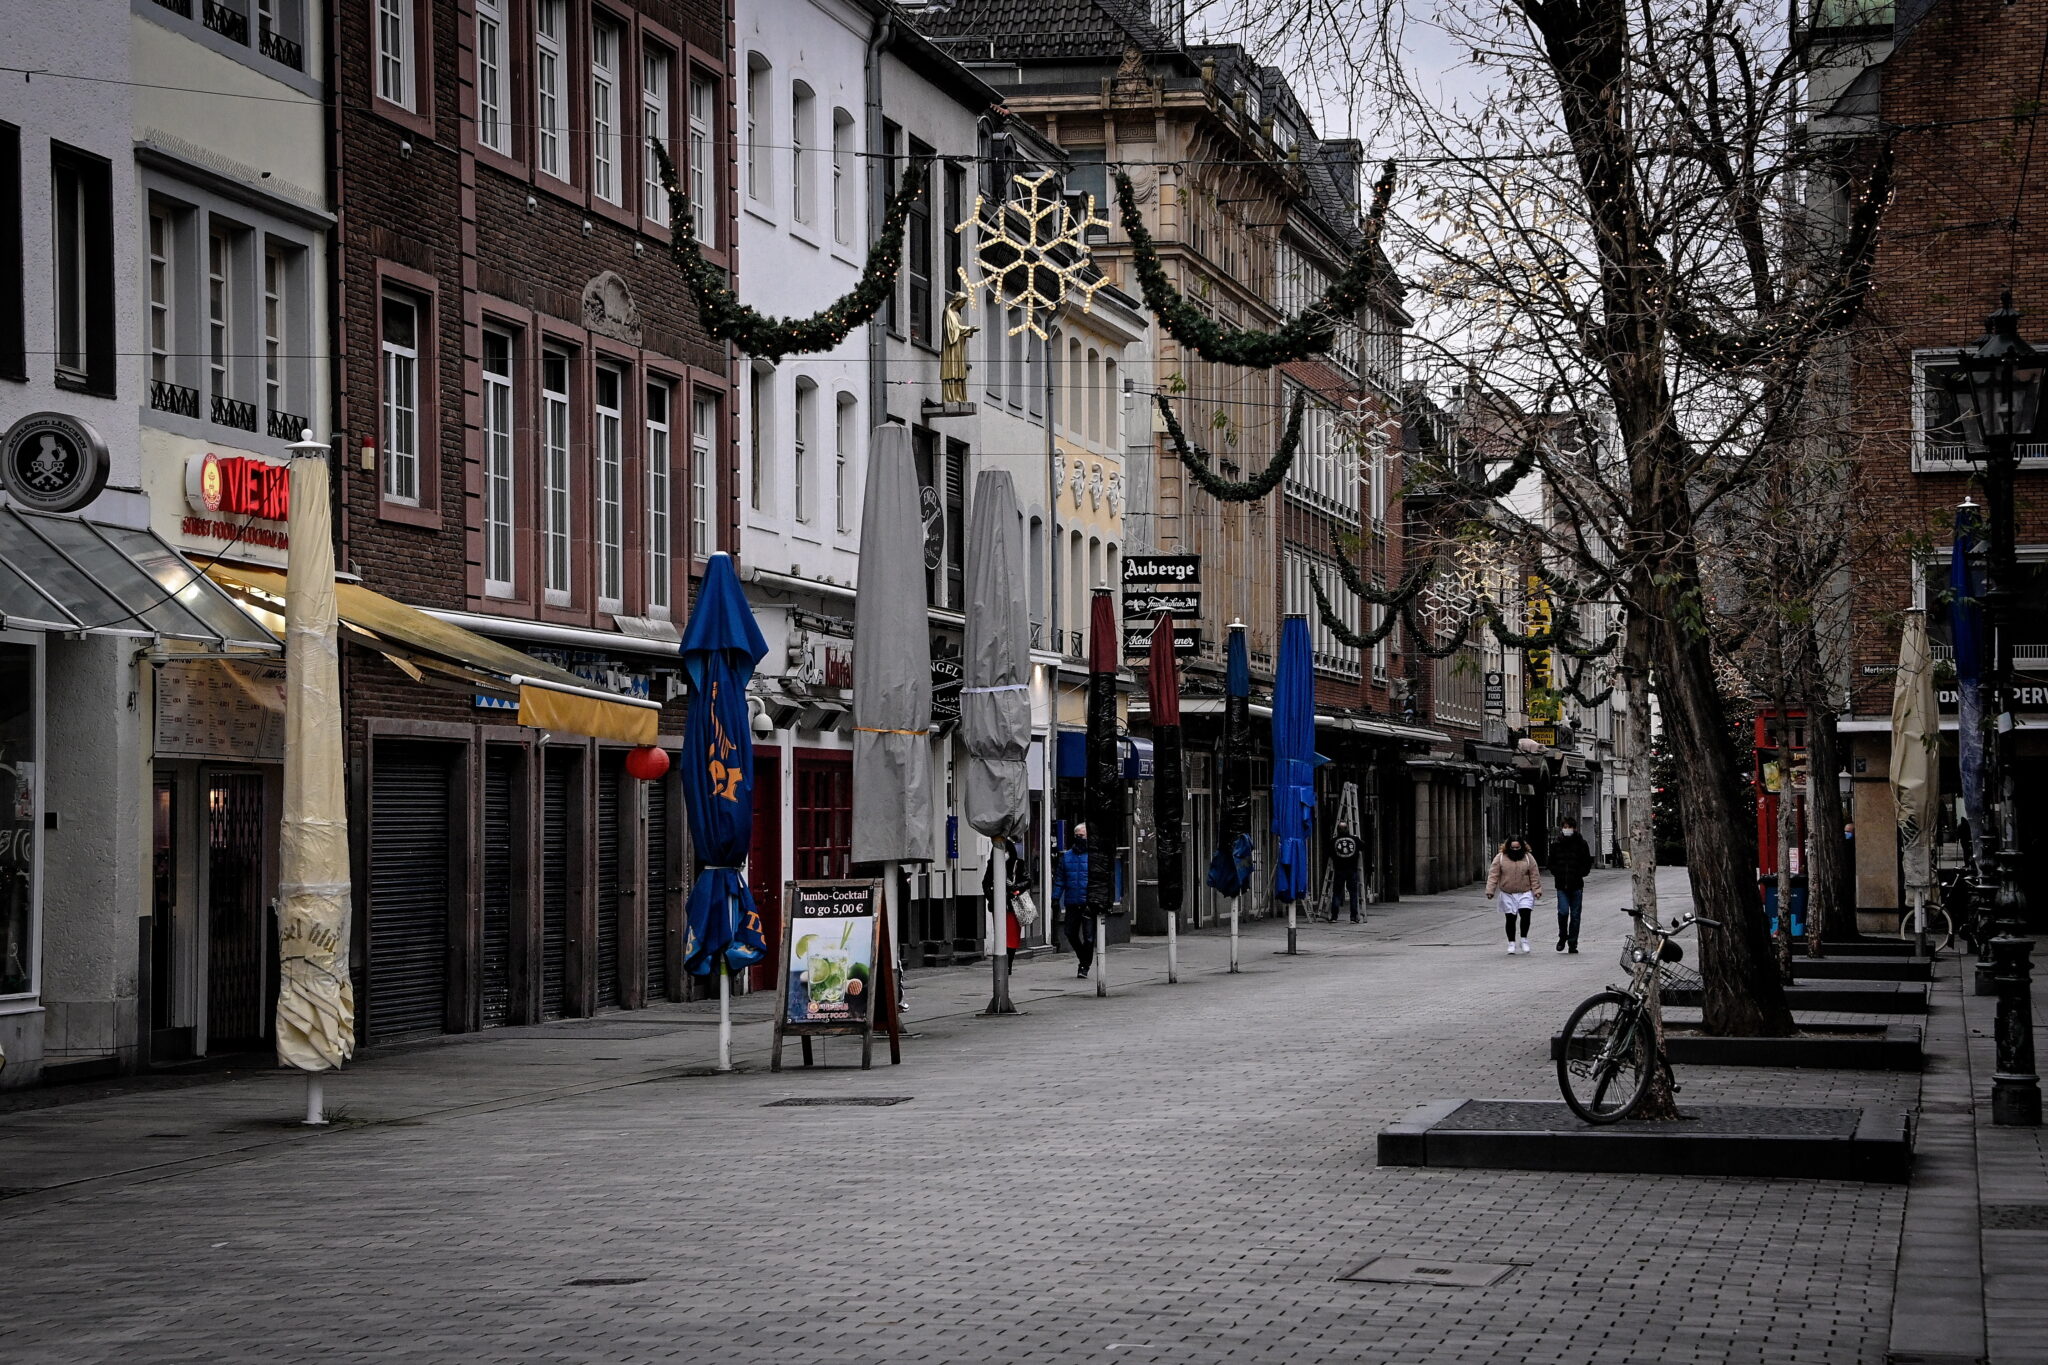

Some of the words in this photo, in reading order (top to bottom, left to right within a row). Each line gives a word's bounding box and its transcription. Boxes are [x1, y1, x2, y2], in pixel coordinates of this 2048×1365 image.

[226, 457, 289, 521] VIETNA
[1124, 559, 1195, 580] Auberge
[931, 662, 959, 678] NGEL
[1487, 692, 1501, 700] FOOD
[800, 890, 868, 902] Jumbo-Cocktail
[804, 905, 816, 915] to
[817, 906, 831, 917] go
